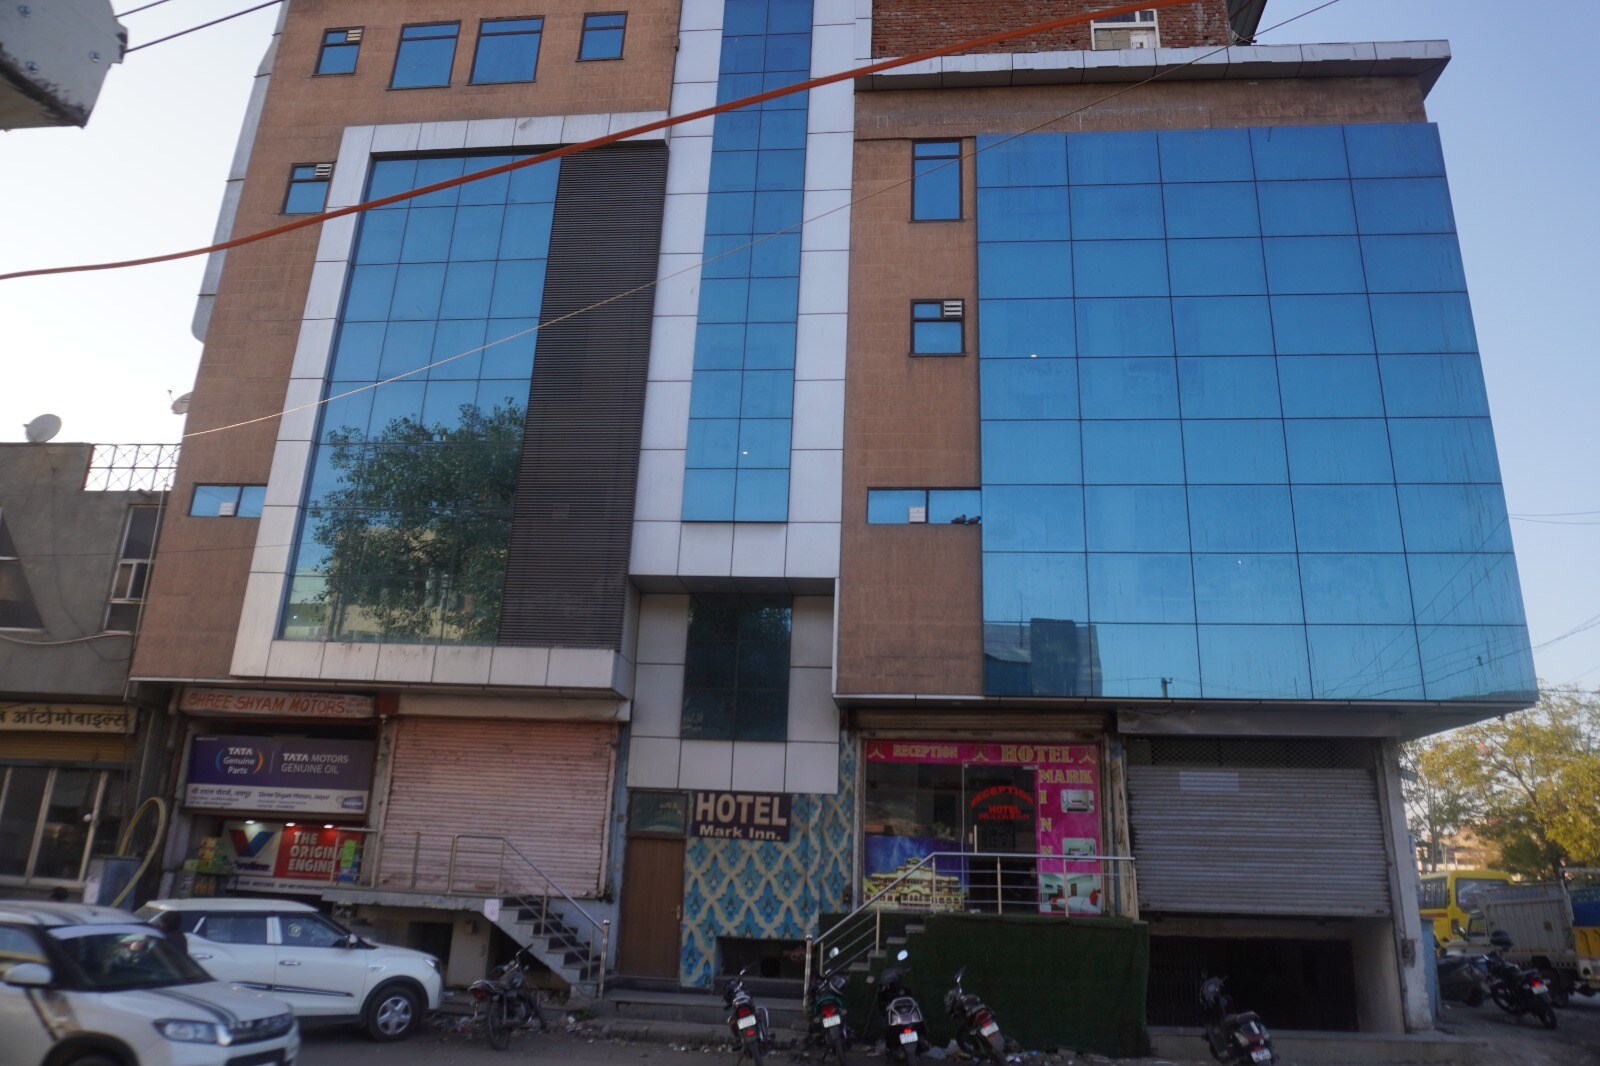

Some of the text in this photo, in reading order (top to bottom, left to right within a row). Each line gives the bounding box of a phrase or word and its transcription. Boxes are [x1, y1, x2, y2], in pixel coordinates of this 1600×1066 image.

[188, 692, 232, 709] SHREE
[234, 695, 286, 711] SHYAM
[288, 697, 345, 714] MOTORS
[228, 747, 253, 755] TATA
[892, 744, 958, 758] RECEPTION
[1001, 744, 1074, 763] HOTEL
[223, 756, 255, 766] Genuine
[282, 753, 348, 764] TATA MOTORS
[227, 766, 248, 775] Parts
[281, 763, 340, 774] GENUINE OIL
[1039, 769, 1094, 784] MARK
[695, 792, 787, 827] HOTEL
[294, 831, 318, 844] THE
[699, 824, 743, 838] Mark
